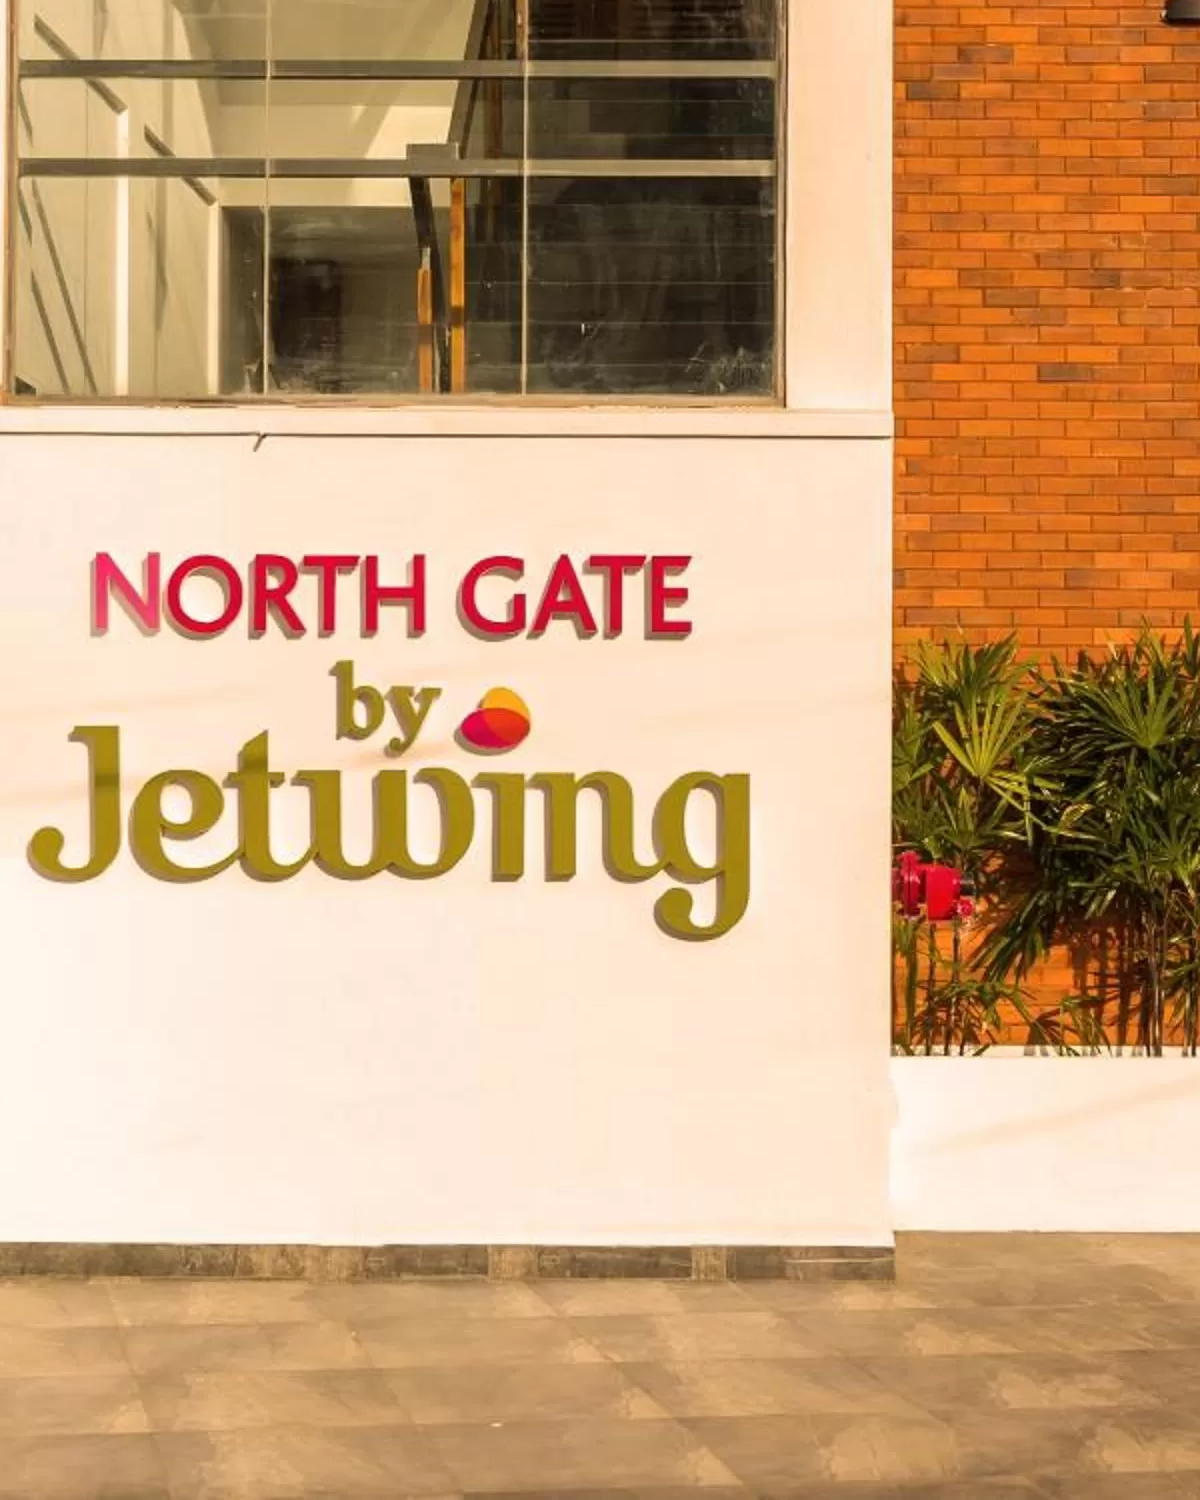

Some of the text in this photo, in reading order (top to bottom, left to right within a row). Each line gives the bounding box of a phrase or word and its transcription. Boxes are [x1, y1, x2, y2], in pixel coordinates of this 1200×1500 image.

[91, 551, 693, 640] NORTH GATE
[330, 660, 442, 756] by
[27, 726, 750, 941] Jetwing
